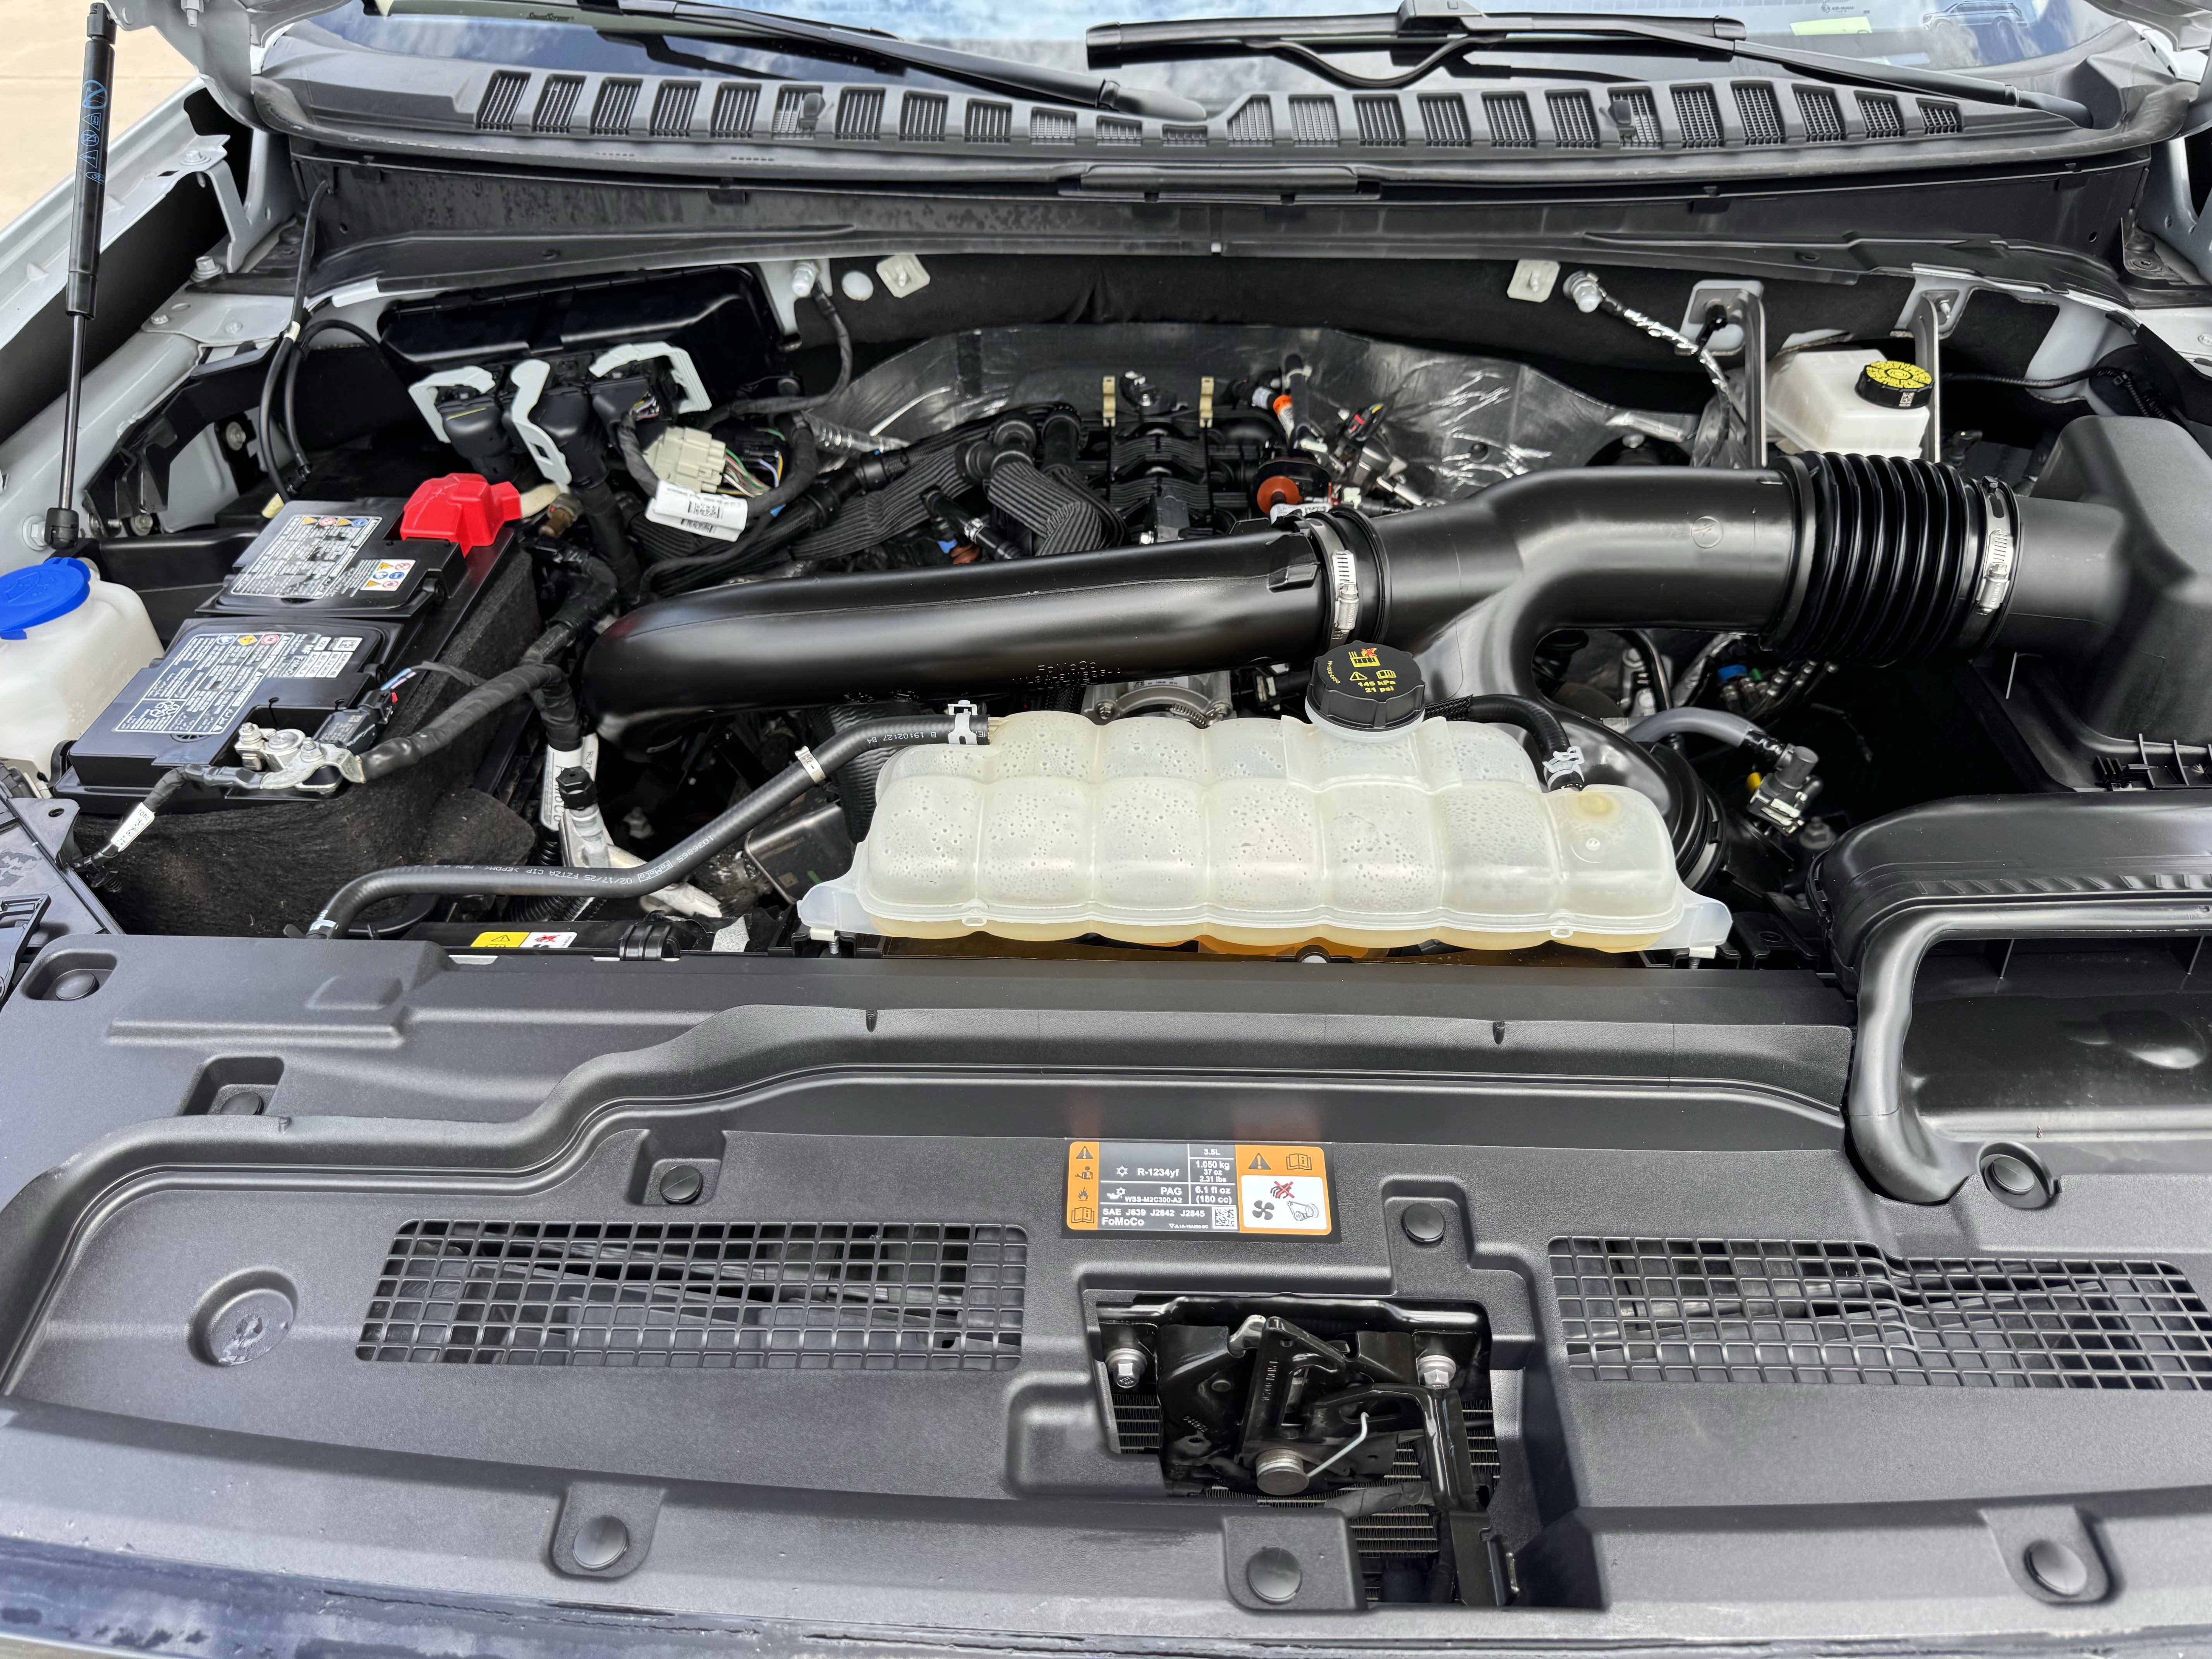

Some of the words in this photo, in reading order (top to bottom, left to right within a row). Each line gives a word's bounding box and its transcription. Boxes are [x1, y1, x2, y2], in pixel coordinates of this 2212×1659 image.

[883, 732, 924, 741] 19:02:27
[677, 835, 714, 863] 1036865
[639, 862, 671, 879] FoMoCo
[584, 874, 633, 884] 02/17/25
[1195, 1160, 1218, 1168] 1.050
[1219, 1161, 1230, 1171] kg
[1137, 1168, 1180, 1178] R-1234yf
[1161, 1187, 1182, 1195] PAG
[1195, 1195, 1215, 1204] (180
[1218, 1196, 1232, 1204] cc)
[1102, 1217, 1145, 1226] FoMoCo
